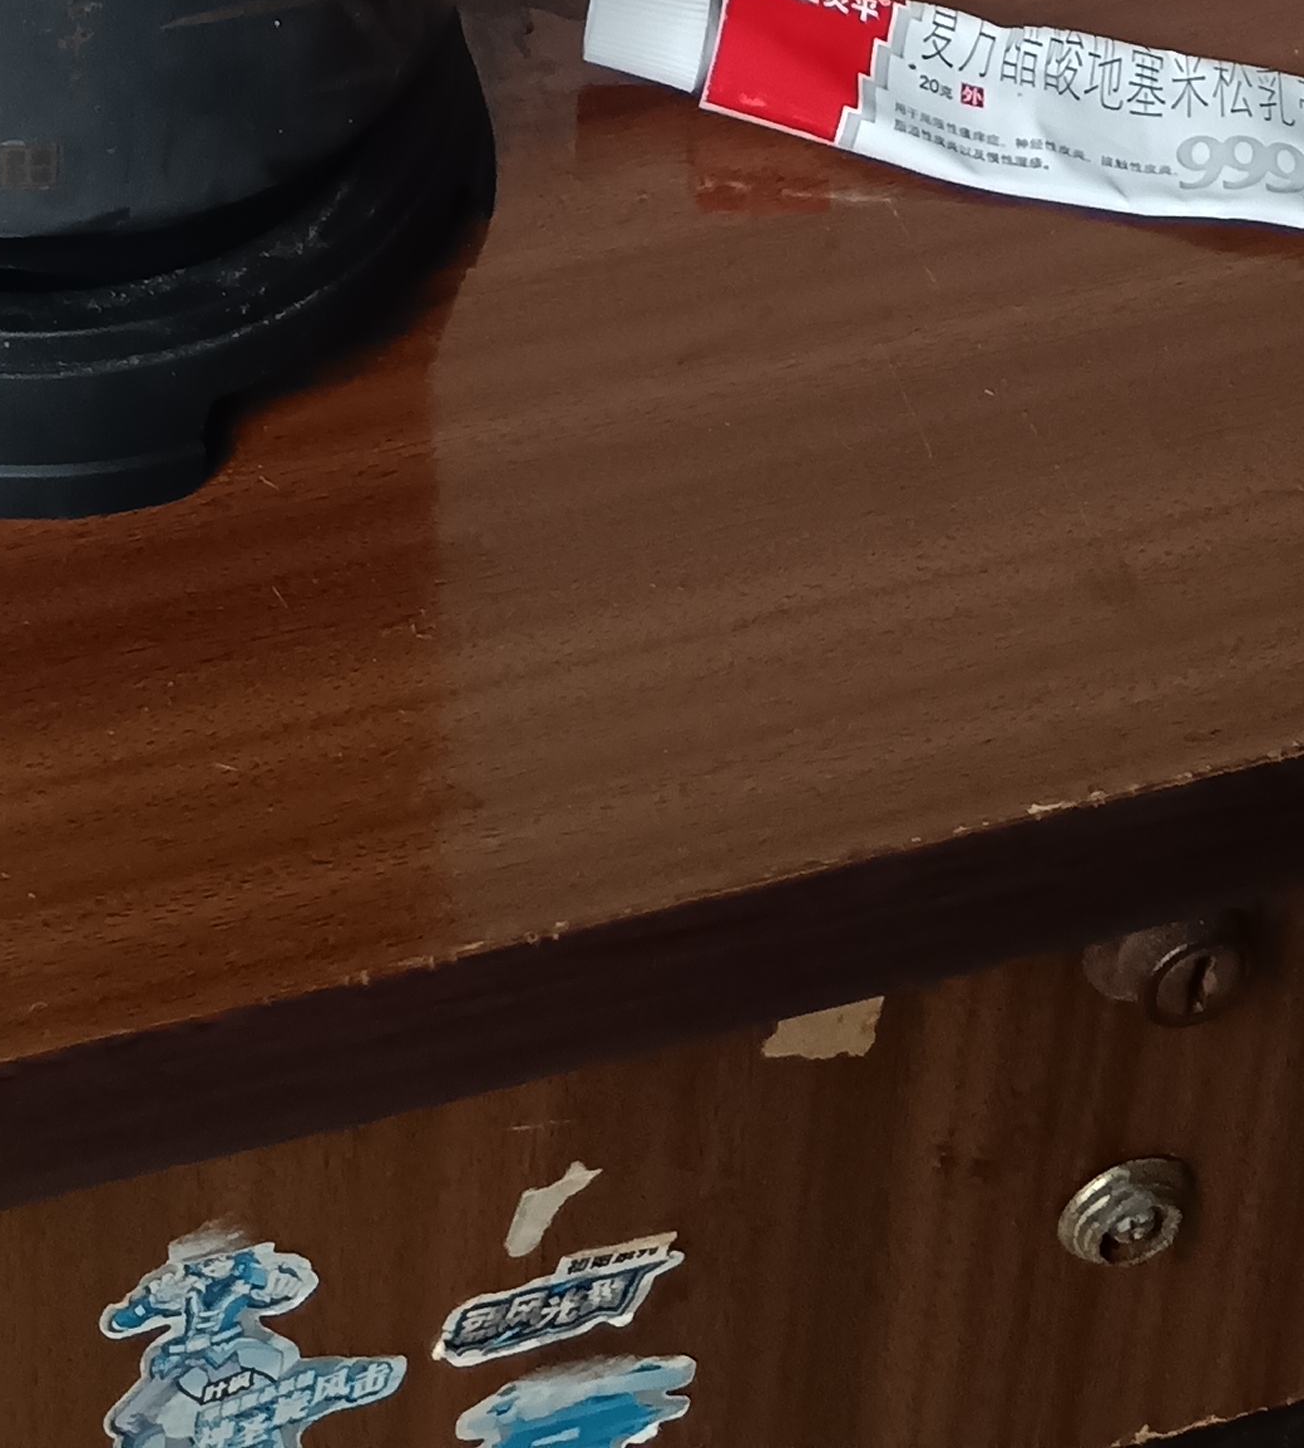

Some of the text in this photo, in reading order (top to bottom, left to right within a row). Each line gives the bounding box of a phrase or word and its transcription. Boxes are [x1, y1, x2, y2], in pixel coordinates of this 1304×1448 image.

[919, 75, 953, 100] 20克
[921, 9, 1304, 128] 复方醋酸地塞米松乳
[1176, 135, 1304, 194] 999
